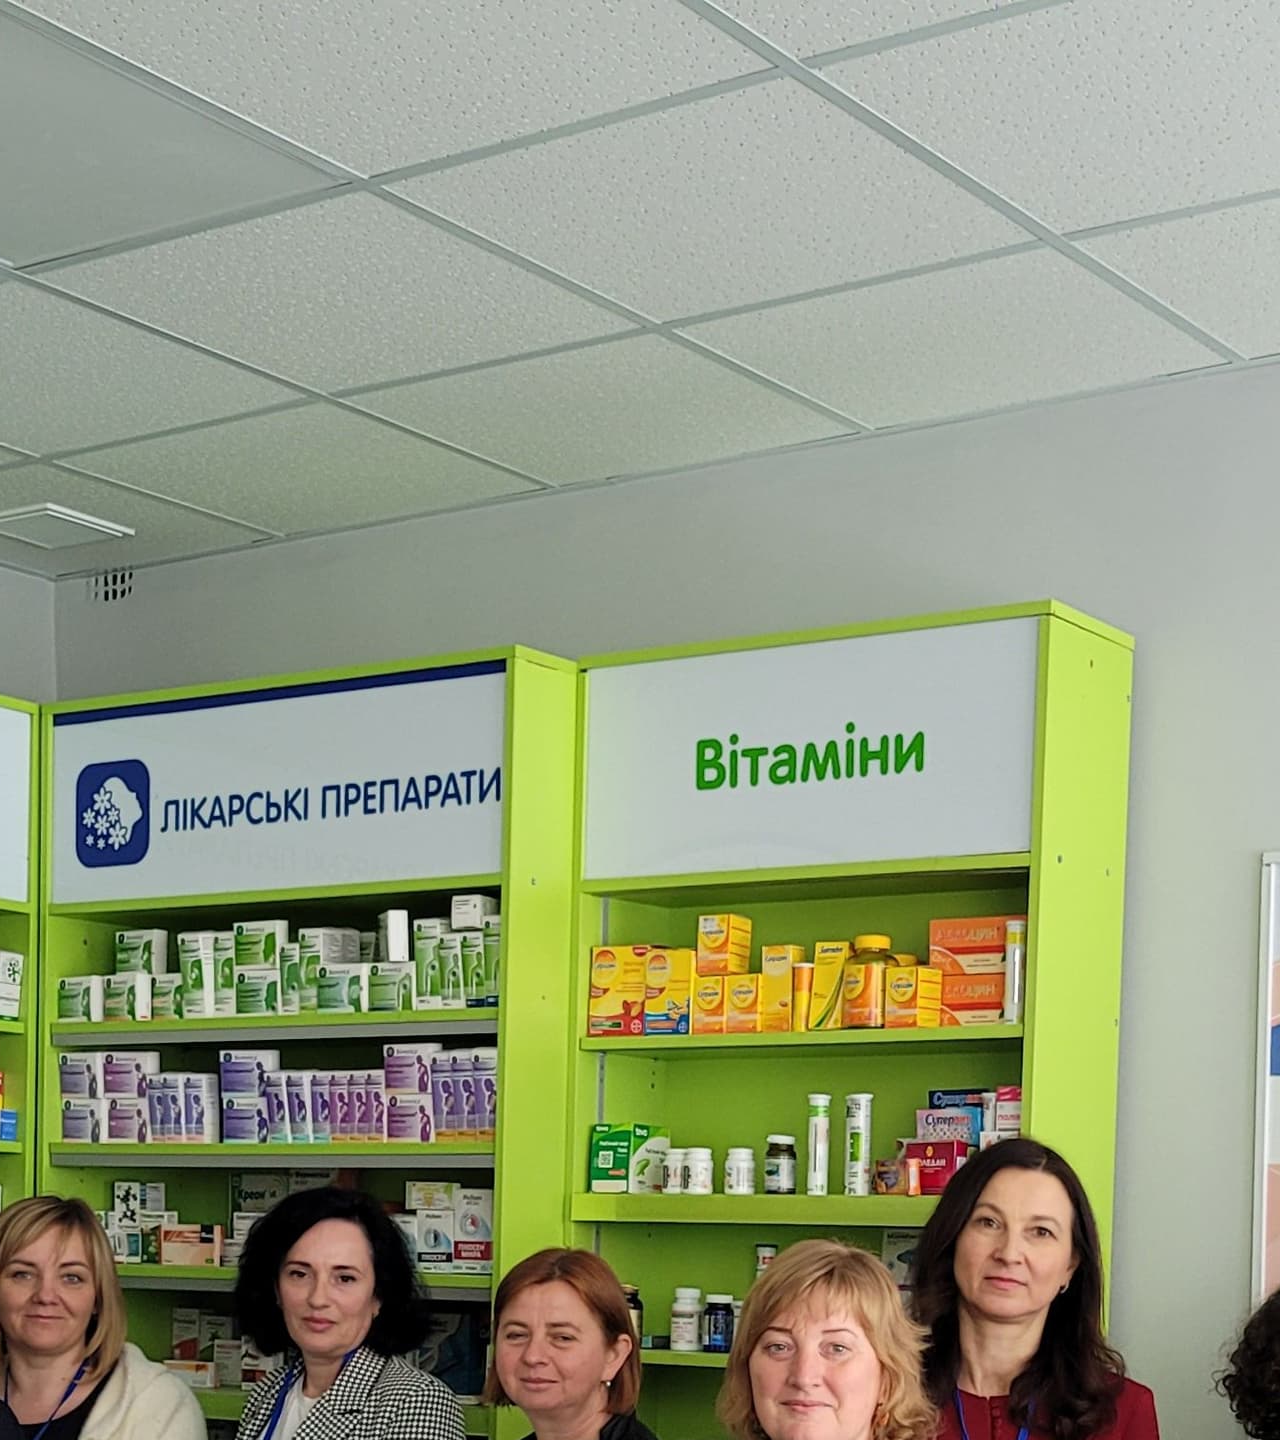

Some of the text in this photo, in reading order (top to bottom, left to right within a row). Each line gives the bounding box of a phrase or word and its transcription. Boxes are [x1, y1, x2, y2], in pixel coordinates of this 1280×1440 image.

[695, 722, 926, 791] Вітаміни
[160, 766, 502, 833] ЛІКАРСЬКІ ПРЕПАРАТИ
